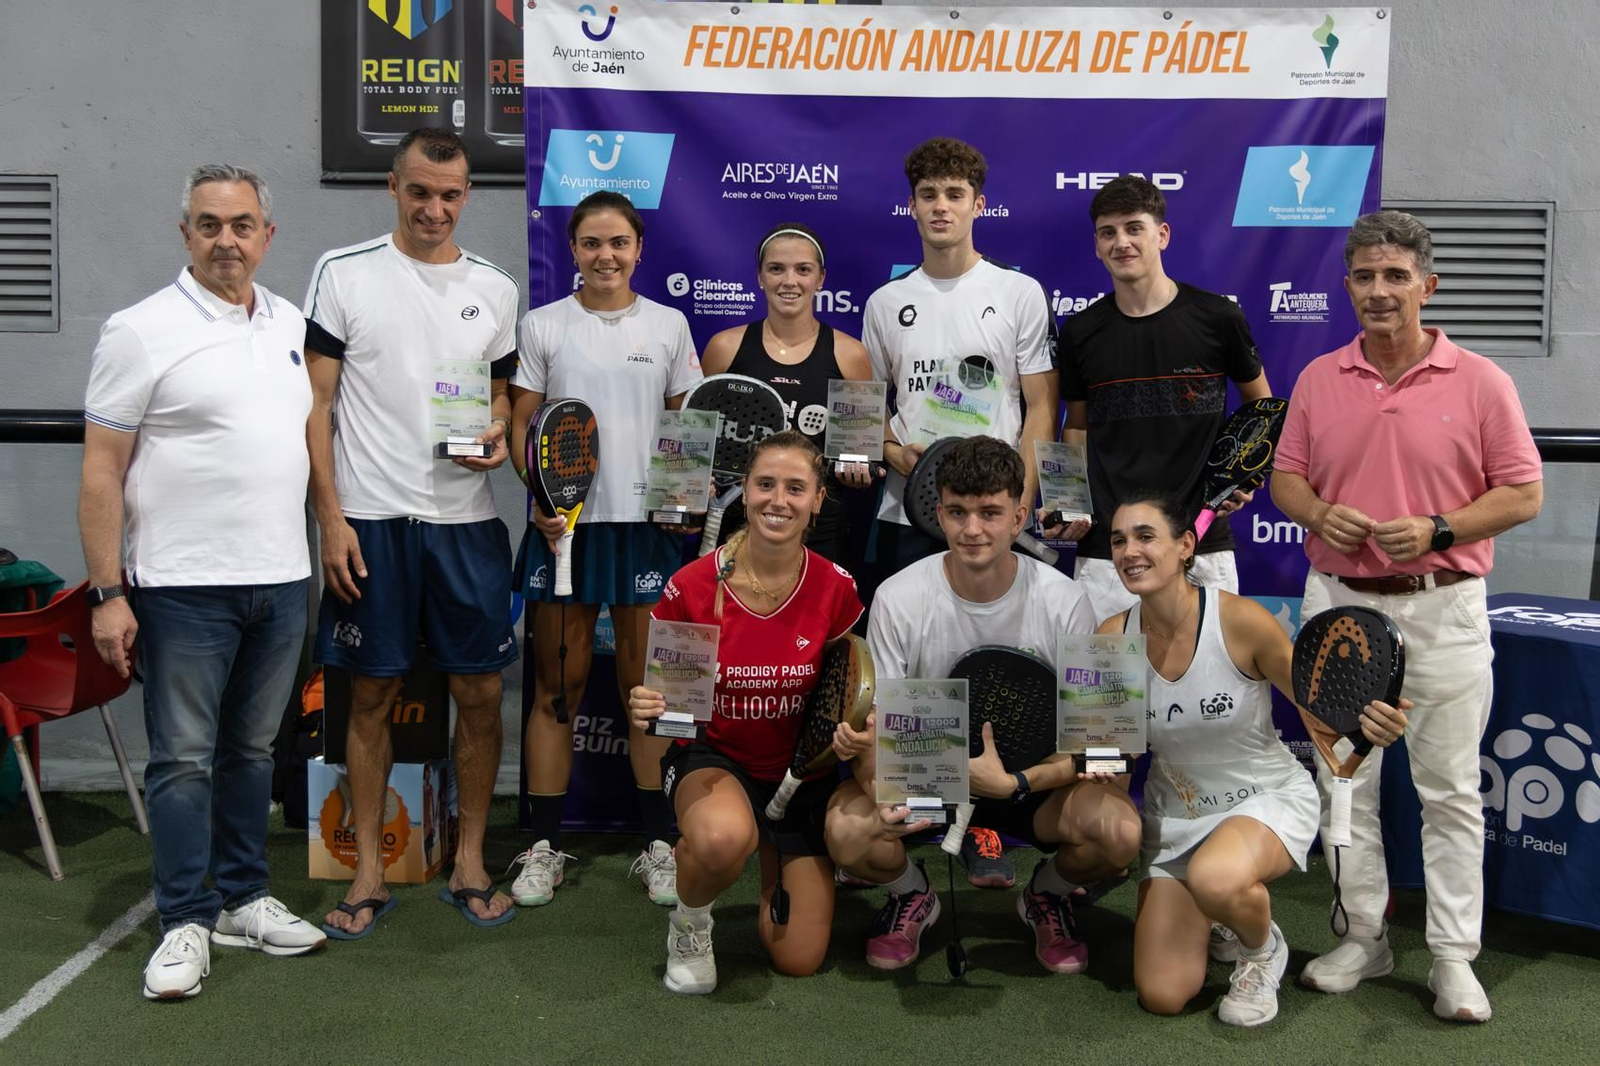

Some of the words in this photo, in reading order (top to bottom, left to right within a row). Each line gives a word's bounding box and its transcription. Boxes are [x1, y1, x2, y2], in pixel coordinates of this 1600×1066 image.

[683, 18, 898, 71] FEDERACIÓN
[899, 29, 1081, 73] ANDALUZA
[1089, 30, 1139, 73] DE
[1142, 21, 1250, 73] PÁDEL
[552, 46, 645, 61] Ayuntamiento
[361, 59, 460, 84] REIGN
[489, 58, 524, 84] RE
[572, 60, 589, 72] de
[592, 61, 625, 74] Jaén
[1290, 71, 1323, 79] Patronato
[1324, 70, 1355, 79] Municipal
[363, 86, 394, 94] TOTAL
[399, 86, 431, 94] BODY
[435, 86, 458, 95] FUEL
[490, 87, 521, 95] TOTAL
[381, 105, 417, 113] LEMON
[721, 162, 776, 183] AIRES
[776, 163, 789, 175] DE
[787, 163, 839, 184] JAÉN
[559, 174, 651, 190] Ayuntamiento
[1056, 172, 1184, 191] HED
[722, 191, 749, 199] Aceite
[750, 191, 762, 199] de
[764, 191, 786, 200] Oliva
[788, 192, 815, 201] Virgen
[817, 192, 838, 201] Extra
[693, 279, 743, 291] Clínicas
[693, 290, 756, 302] Cleardent
[694, 302, 713, 310] Grupo
[714, 302, 753, 310] odontológico
[1289, 299, 1328, 309] ANTEQUERA
[627, 355, 654, 364] PADEL
[635, 573, 657, 590] fap
[726, 665, 778, 678] PRODIGY
[781, 663, 816, 677] PADEL
[726, 679, 778, 689] ACADEMY
[781, 678, 803, 689] APP
[712, 692, 805, 720] HELIOCAR
[1200, 698, 1226, 716] fap
[572, 715, 614, 735] PIZ
[888, 714, 916, 731] JAEN
[925, 718, 956, 727] 12000
[1479, 754, 1565, 831] ap
[1500, 832, 1518, 848] de
[1522, 834, 1567, 856] Padel
